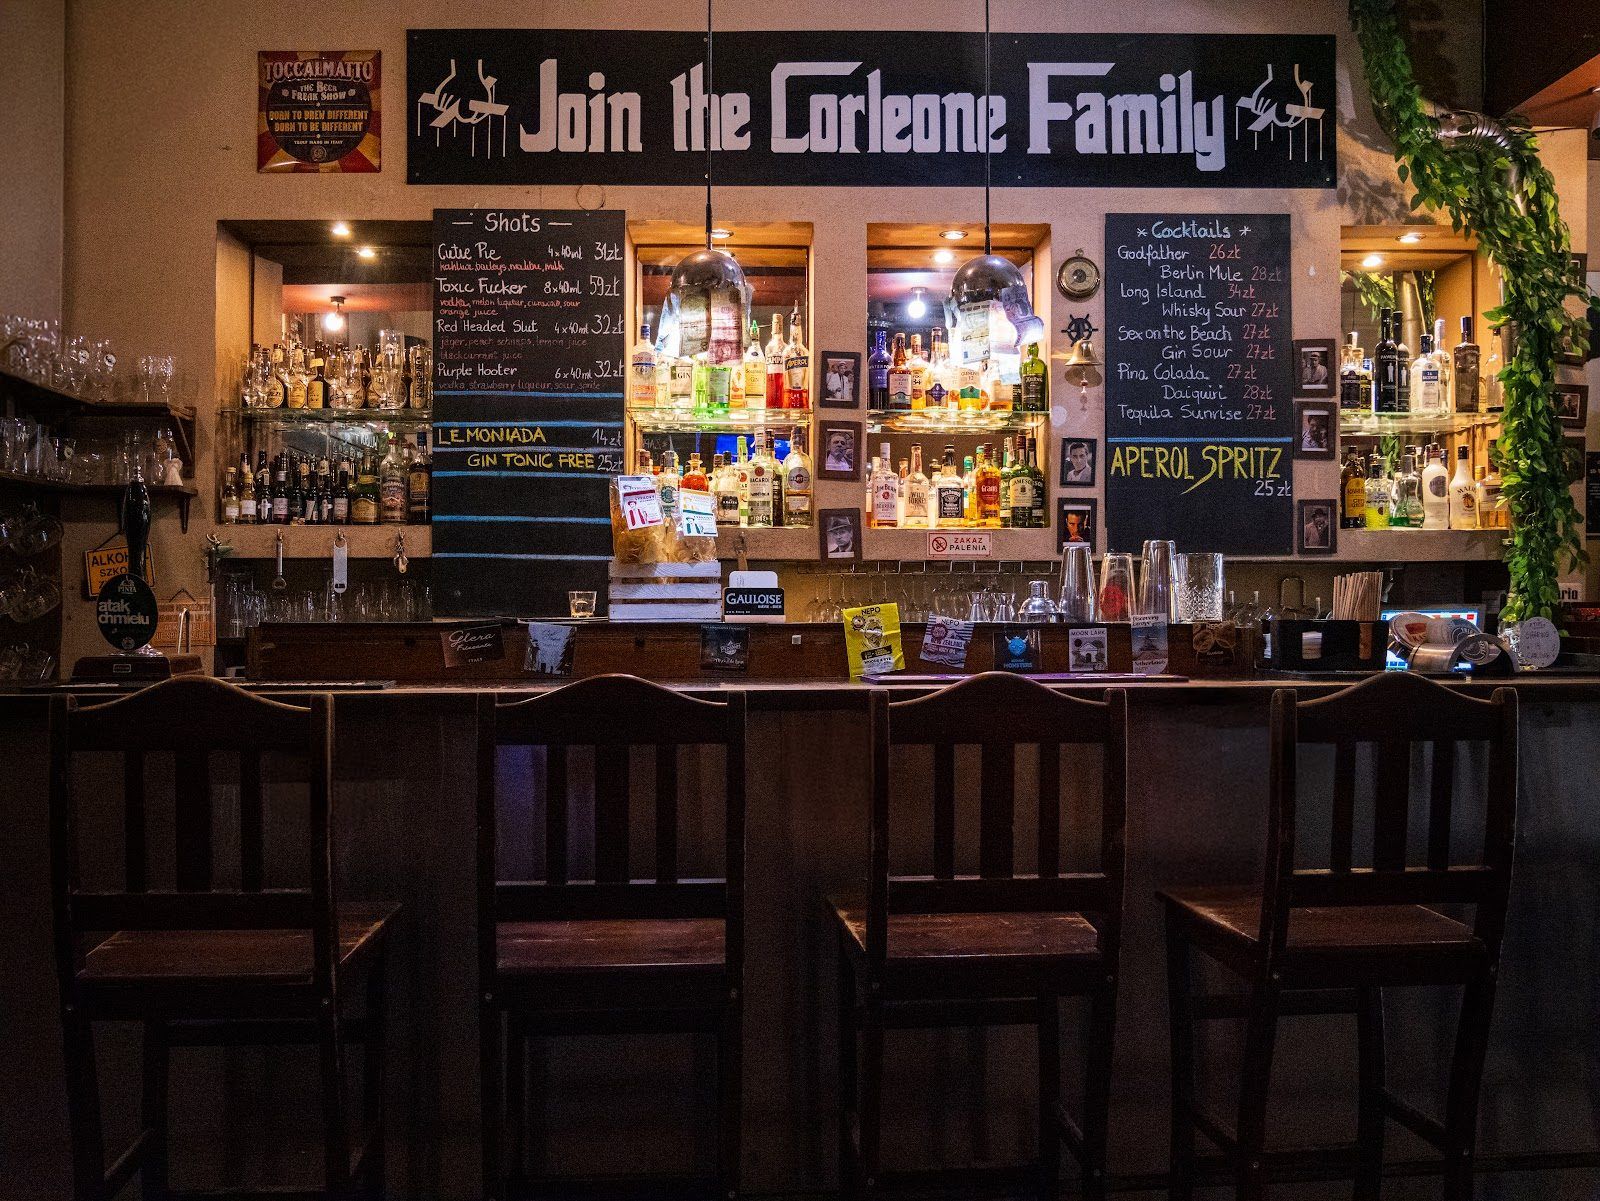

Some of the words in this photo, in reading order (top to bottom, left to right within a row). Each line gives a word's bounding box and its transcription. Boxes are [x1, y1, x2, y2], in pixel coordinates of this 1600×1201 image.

[264, 61, 375, 81] TOCCALMATTO
[519, 58, 643, 153] Join
[670, 62, 751, 152] the
[770, 61, 1007, 153] Corleone
[1026, 62, 1226, 172] Family
[484, 212, 541, 233] Shots
[1151, 219, 1232, 239] Cocktails
[437, 243, 472, 261] Cutie
[475, 242, 501, 260] Pie
[1117, 244, 1190, 267] Godfather
[1160, 265, 1205, 280] Berlin
[1209, 265, 1244, 282] Mule
[435, 277, 475, 293] Toxic
[478, 277, 528, 295] Fucker
[1120, 283, 1150, 305] Long
[1156, 283, 1206, 299] Island
[1162, 303, 1211, 325] Whisky
[1214, 302, 1247, 318] Sour
[435, 319, 458, 333] Red
[463, 319, 506, 333] Headed
[512, 319, 538, 333] Slut
[1118, 326, 1143, 341] Sex
[1145, 328, 1161, 340] on
[1164, 325, 1187, 340] the
[1190, 326, 1233, 341] Beach
[1161, 345, 1187, 360] Gin
[1192, 343, 1233, 359] Sour
[437, 362, 473, 379] Purple
[477, 364, 518, 377] Hooter
[1117, 362, 1149, 381] Pina
[1153, 362, 1210, 381] Colada
[1161, 384, 1228, 405] Daiquiri
[1117, 404, 1173, 426] Tequila
[1180, 404, 1243, 421] Sunrise
[438, 427, 547, 445] LEMONIADA
[467, 453, 498, 468] GIN
[502, 452, 554, 468] TONIC
[557, 453, 595, 469] FREE
[1110, 446, 1195, 480] APEROL
[1180, 445, 1283, 495] SPRITZ
[99, 566, 128, 577] SZKO
[98, 599, 131, 615] atak
[726, 592, 782, 605] GAULOISE
[98, 612, 150, 625] chmielu
[861, 606, 881, 616] NEPO
